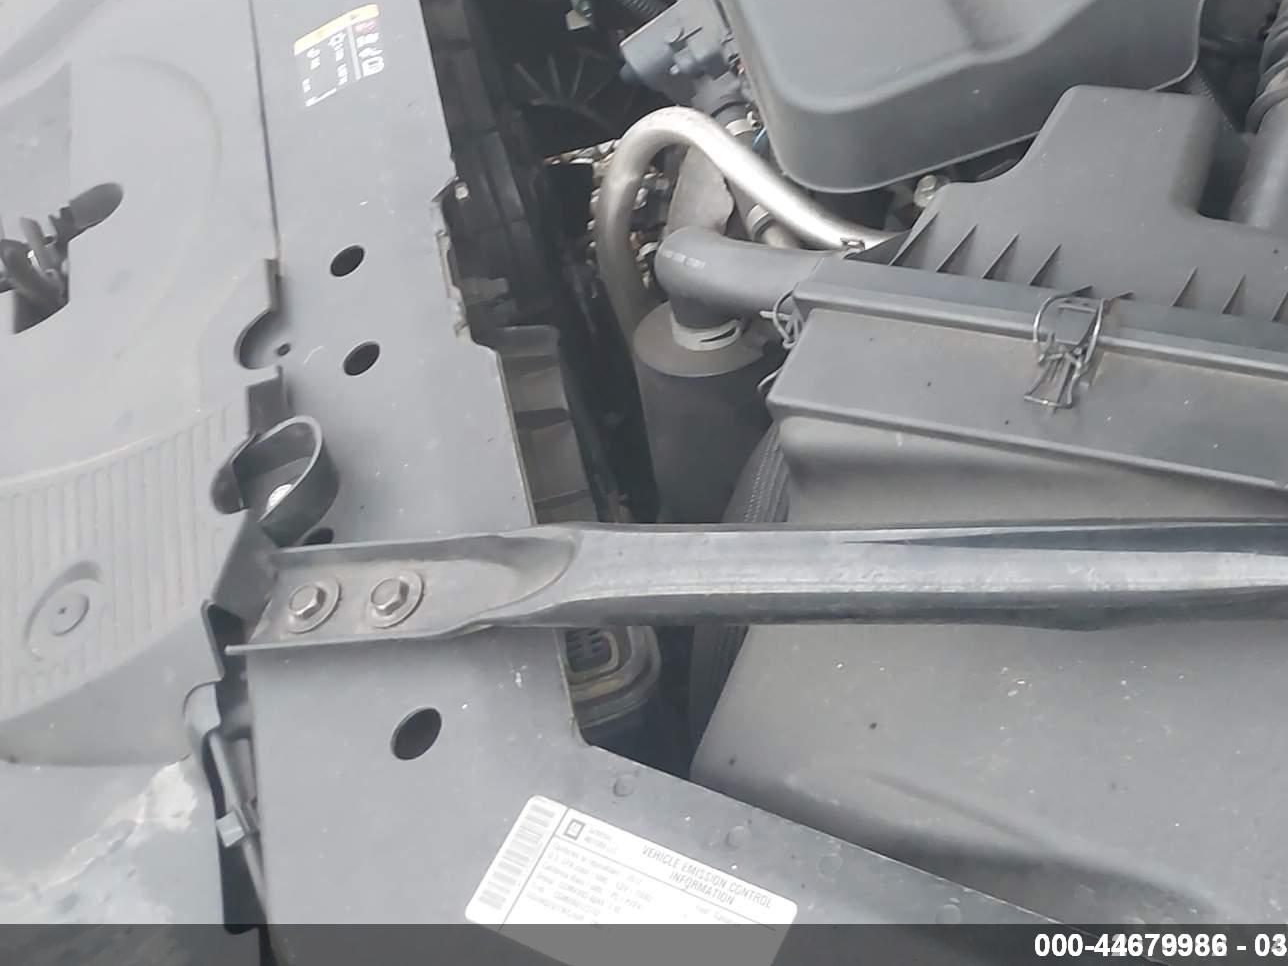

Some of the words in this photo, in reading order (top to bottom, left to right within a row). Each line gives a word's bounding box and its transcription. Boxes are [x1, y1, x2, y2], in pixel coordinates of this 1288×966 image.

[642, 844, 680, 869] VEHICLE
[681, 862, 728, 889] EMISSION
[729, 881, 773, 909] CONTROL
[669, 871, 735, 906] INFORMATION
